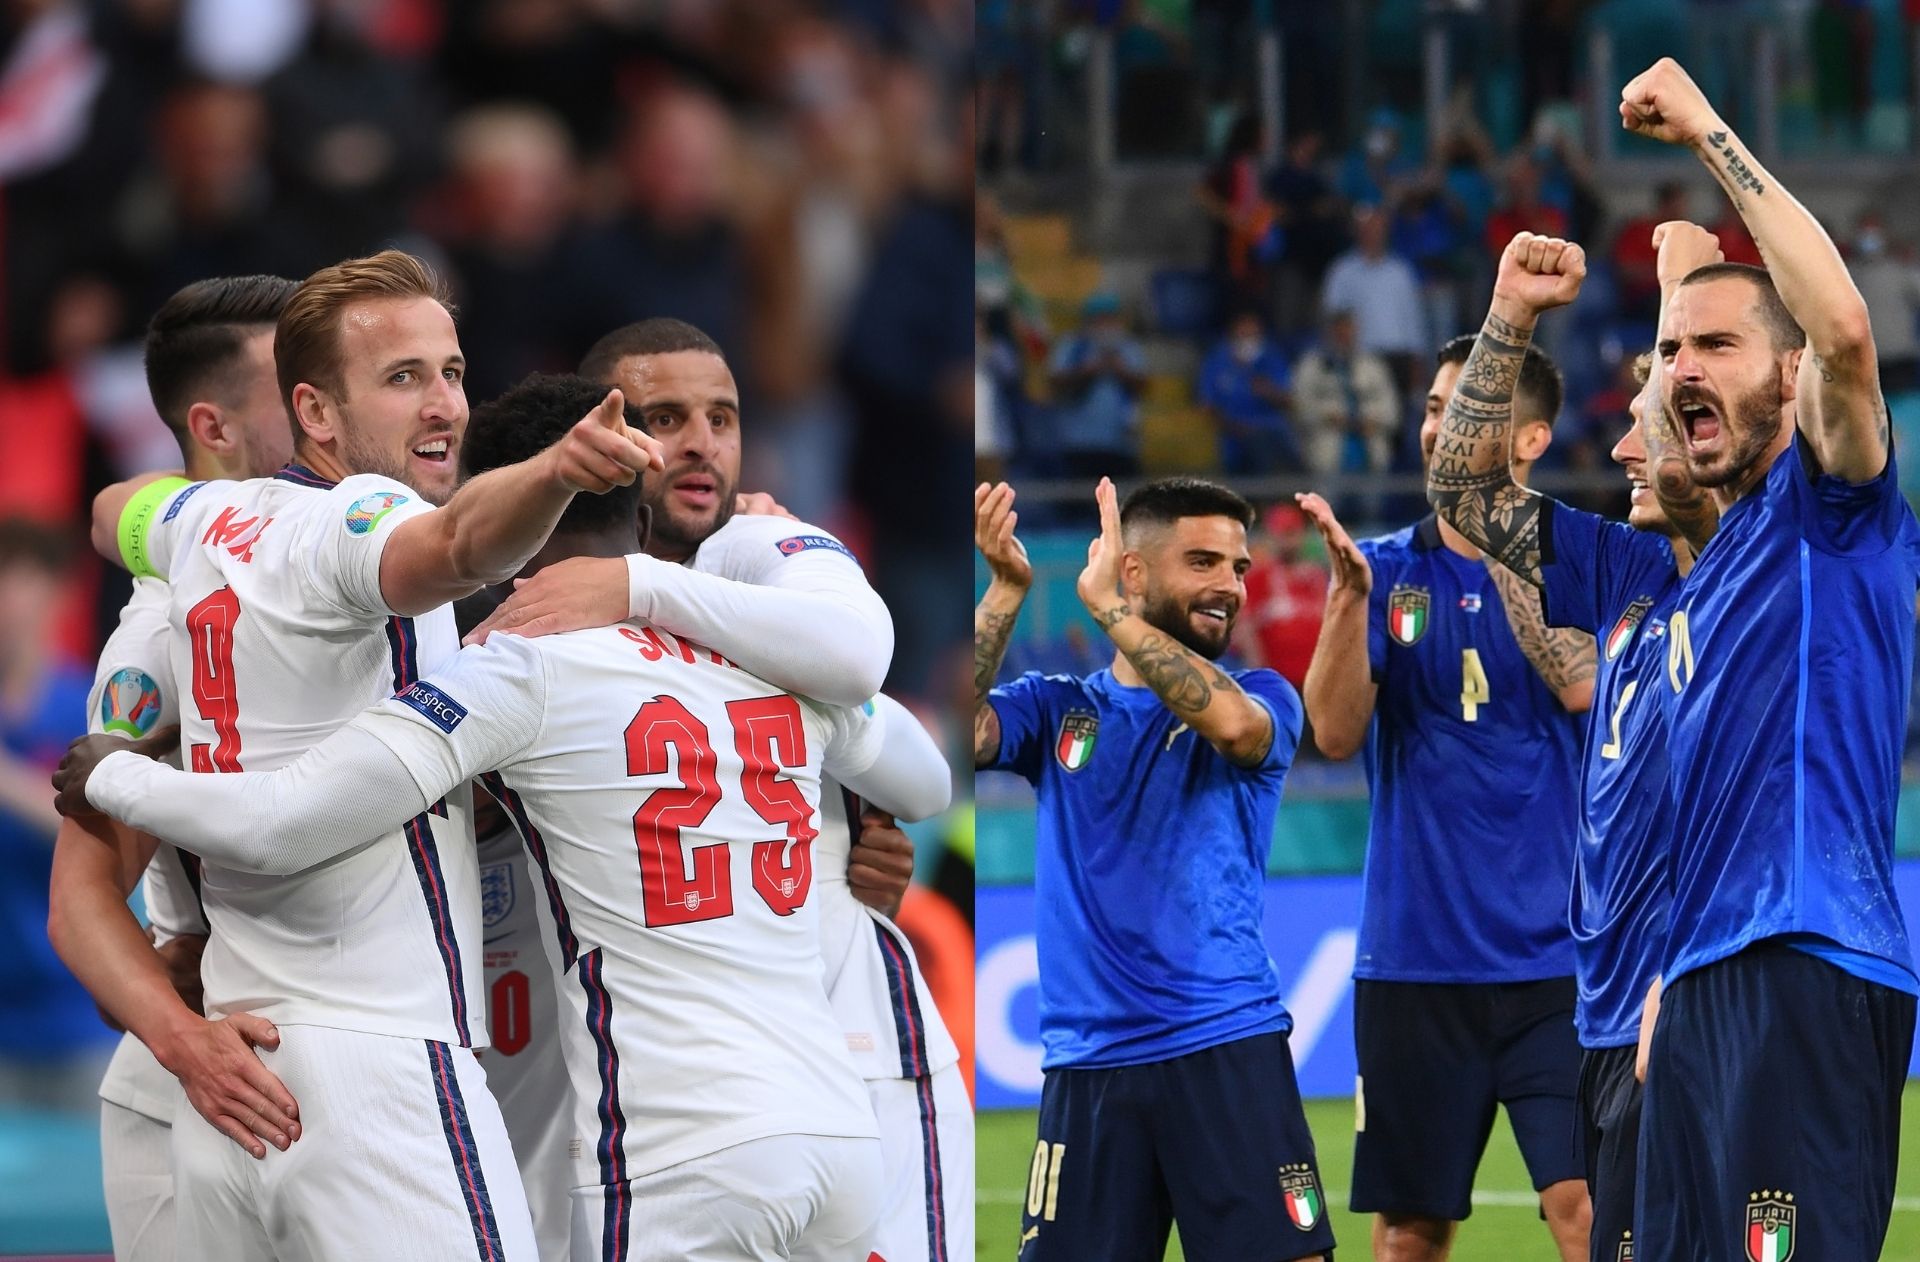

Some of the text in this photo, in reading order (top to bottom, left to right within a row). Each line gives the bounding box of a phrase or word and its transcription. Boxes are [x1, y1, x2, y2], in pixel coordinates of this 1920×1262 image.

[201, 506, 275, 564] KAE
[186, 583, 244, 774] 9
[408, 686, 462, 726] RESPECT
[623, 694, 820, 929] 25
[474, 969, 532, 1058] 0
